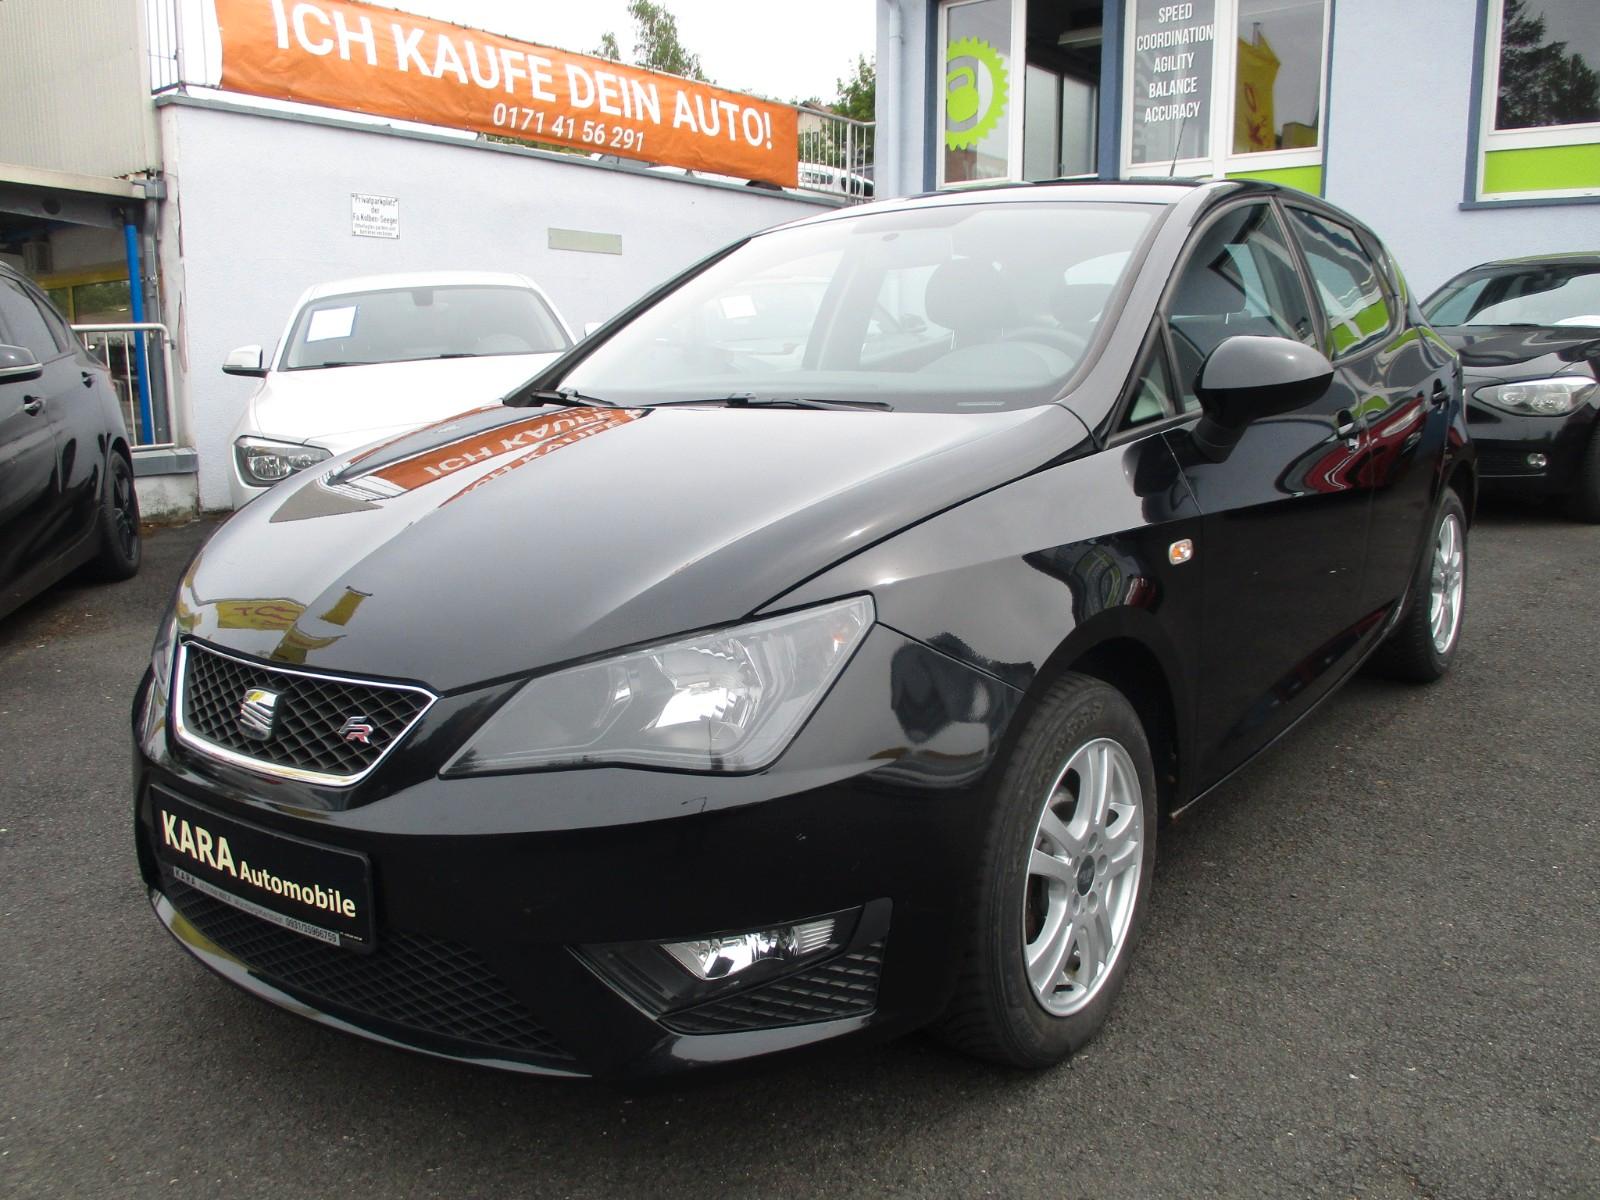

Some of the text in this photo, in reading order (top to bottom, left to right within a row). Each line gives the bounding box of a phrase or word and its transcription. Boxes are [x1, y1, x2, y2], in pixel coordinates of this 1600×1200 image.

[1158, 3, 1193, 23] SPEED
[1136, 24, 1215, 52] COORDINATION
[271, 0, 774, 150] ICH KAUFE DEIN AUTO!
[1153, 52, 1195, 74] AGILITY
[1149, 77, 1198, 99] BALANCE
[1144, 101, 1201, 123] ACCURACY
[492, 102, 644, 152] 0171 41 56 291
[161, 809, 238, 877] KARA
[240, 860, 357, 918] Automobile
